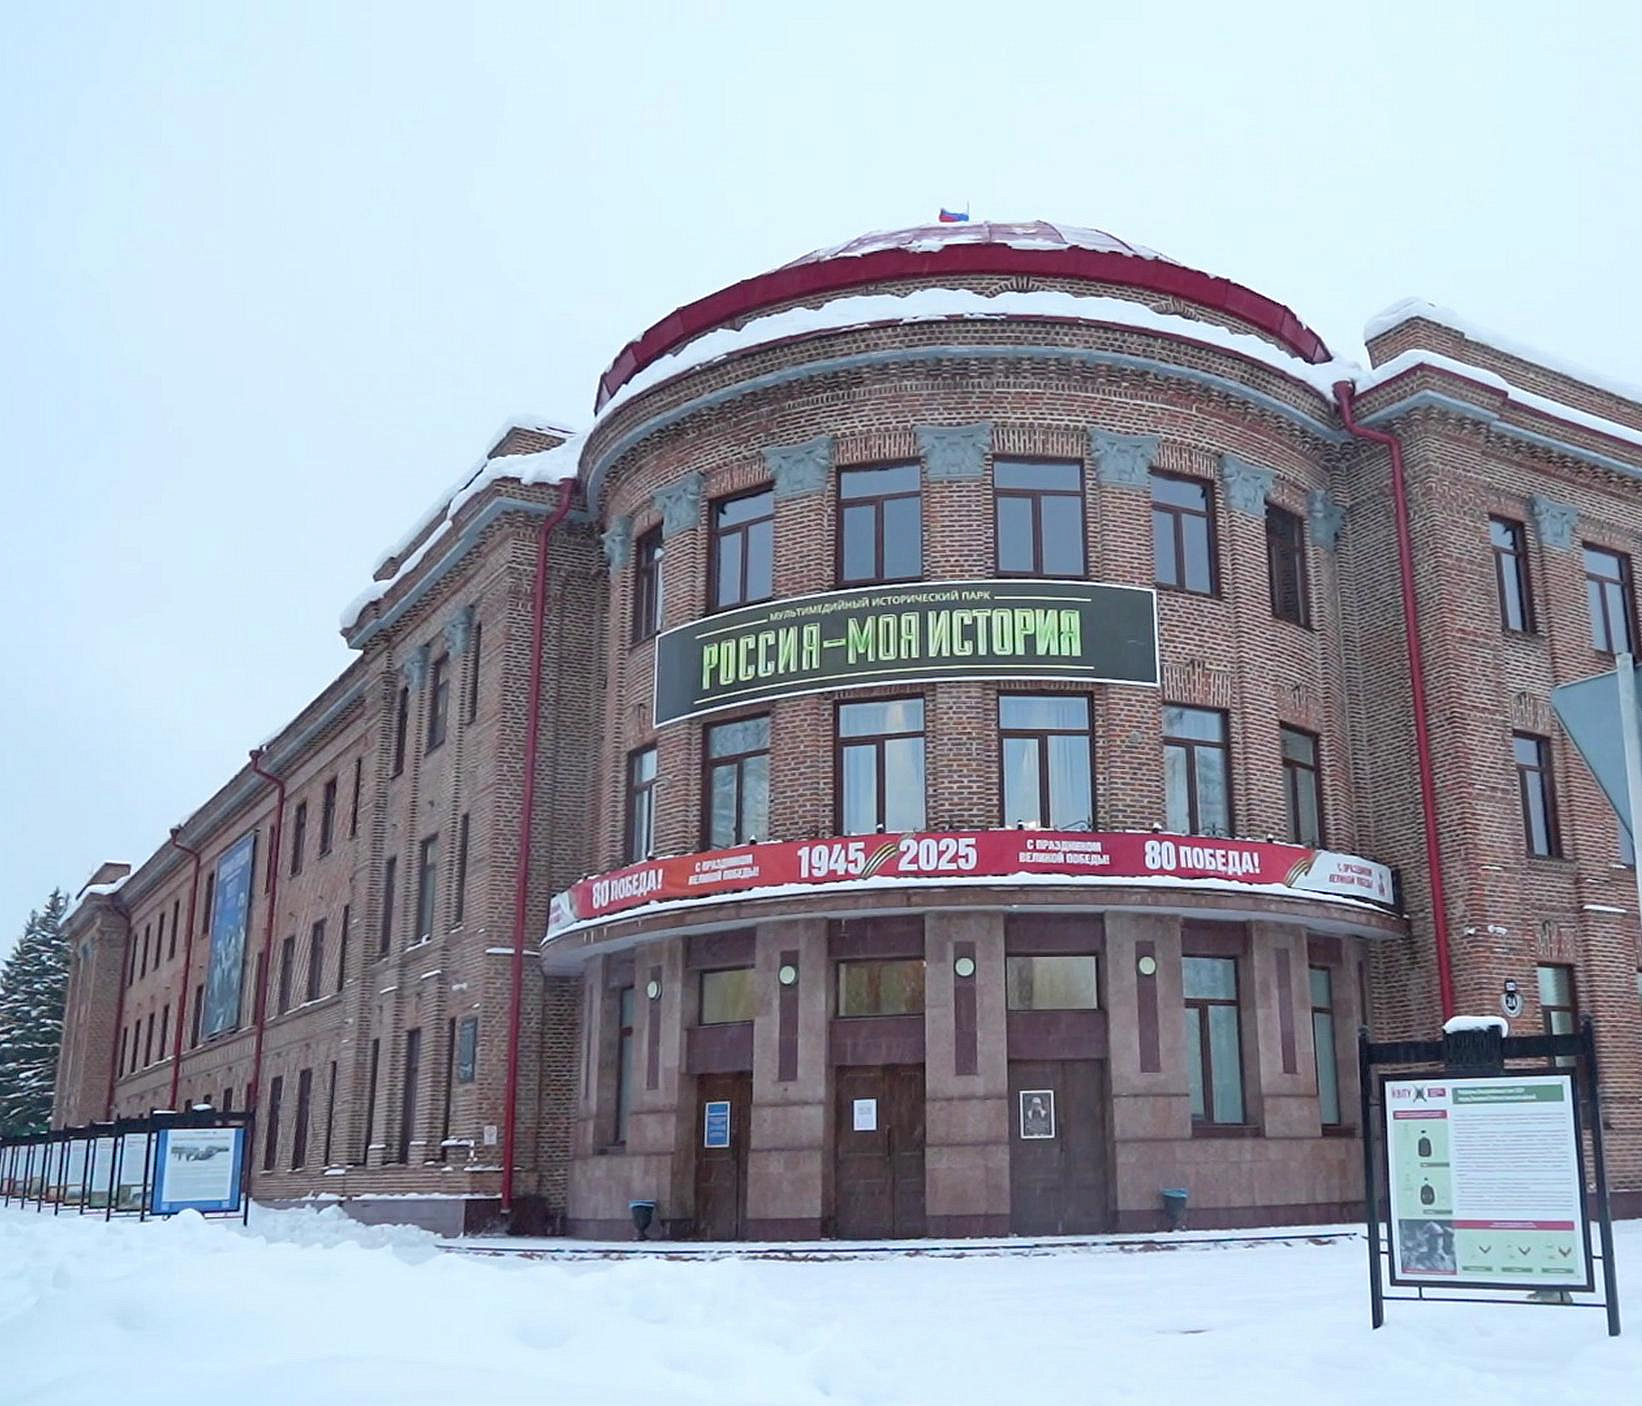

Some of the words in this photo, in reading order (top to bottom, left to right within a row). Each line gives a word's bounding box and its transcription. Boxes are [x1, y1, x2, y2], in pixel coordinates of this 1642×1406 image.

[769, 597, 869, 621] МУЛЬТИМЕДИЙНЫЙ
[871, 590, 959, 607] ИСТОРИЧЕСКИЙ
[961, 591, 991, 601] ПАРК
[928, 608, 1082, 657] ИСТОРИЯ
[797, 842, 867, 879] 1945
[898, 837, 977, 872] 2025
[1144, 840, 1176, 871] 80
[1179, 845, 1260, 876] ПОБЕДА!
[592, 880, 610, 909] 80
[611, 868, 664, 901] ПОБЕДА!
